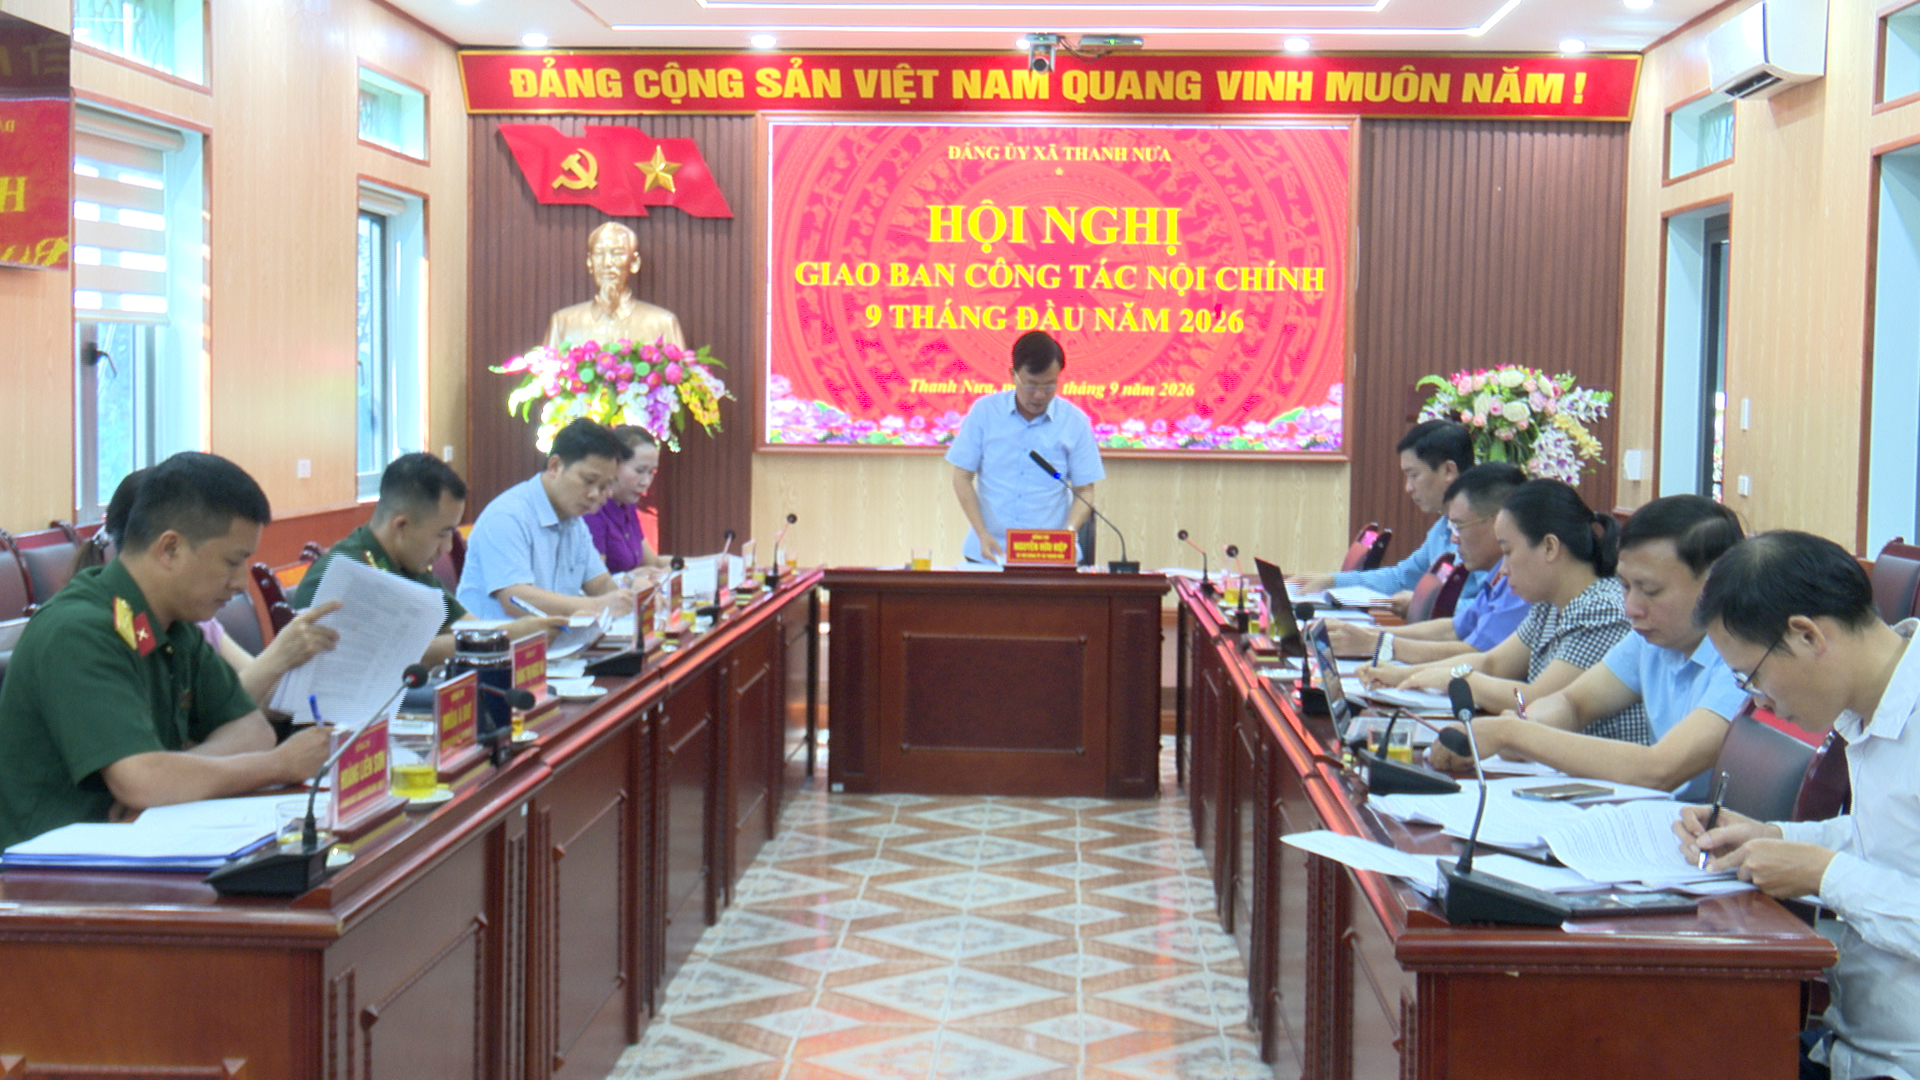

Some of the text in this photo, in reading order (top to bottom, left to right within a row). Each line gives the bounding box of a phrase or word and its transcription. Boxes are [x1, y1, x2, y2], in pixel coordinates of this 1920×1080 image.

[509, 57, 622, 99] ĐẢNG
[634, 61, 744, 104] CỘNG
[755, 57, 842, 99] SẢN
[853, 63, 939, 104] VIỆT
[952, 69, 1050, 100] NAM
[1062, 69, 1202, 104] QUANG
[1216, 71, 1313, 102] VINH
[1325, 65, 1450, 103] MUÔN
[1033, 143, 1059, 161] XÃ
[1062, 146, 1128, 161] THANH
[1132, 144, 1172, 162] NƯA
[926, 198, 1183, 256] HỘI NGHỊ
[795, 257, 1327, 298] GIAO BAN CÔNG TÁC NỘI CHÍNH
[865, 297, 1244, 334] 9 THÁNG ĐẦU NĂM 2026
[909, 378, 957, 394] Thanh
[1062, 380, 1106, 399] tháng
[1110, 381, 1119, 396] 9
[1122, 381, 1155, 397] năm
[1159, 381, 1196, 397] 2026
